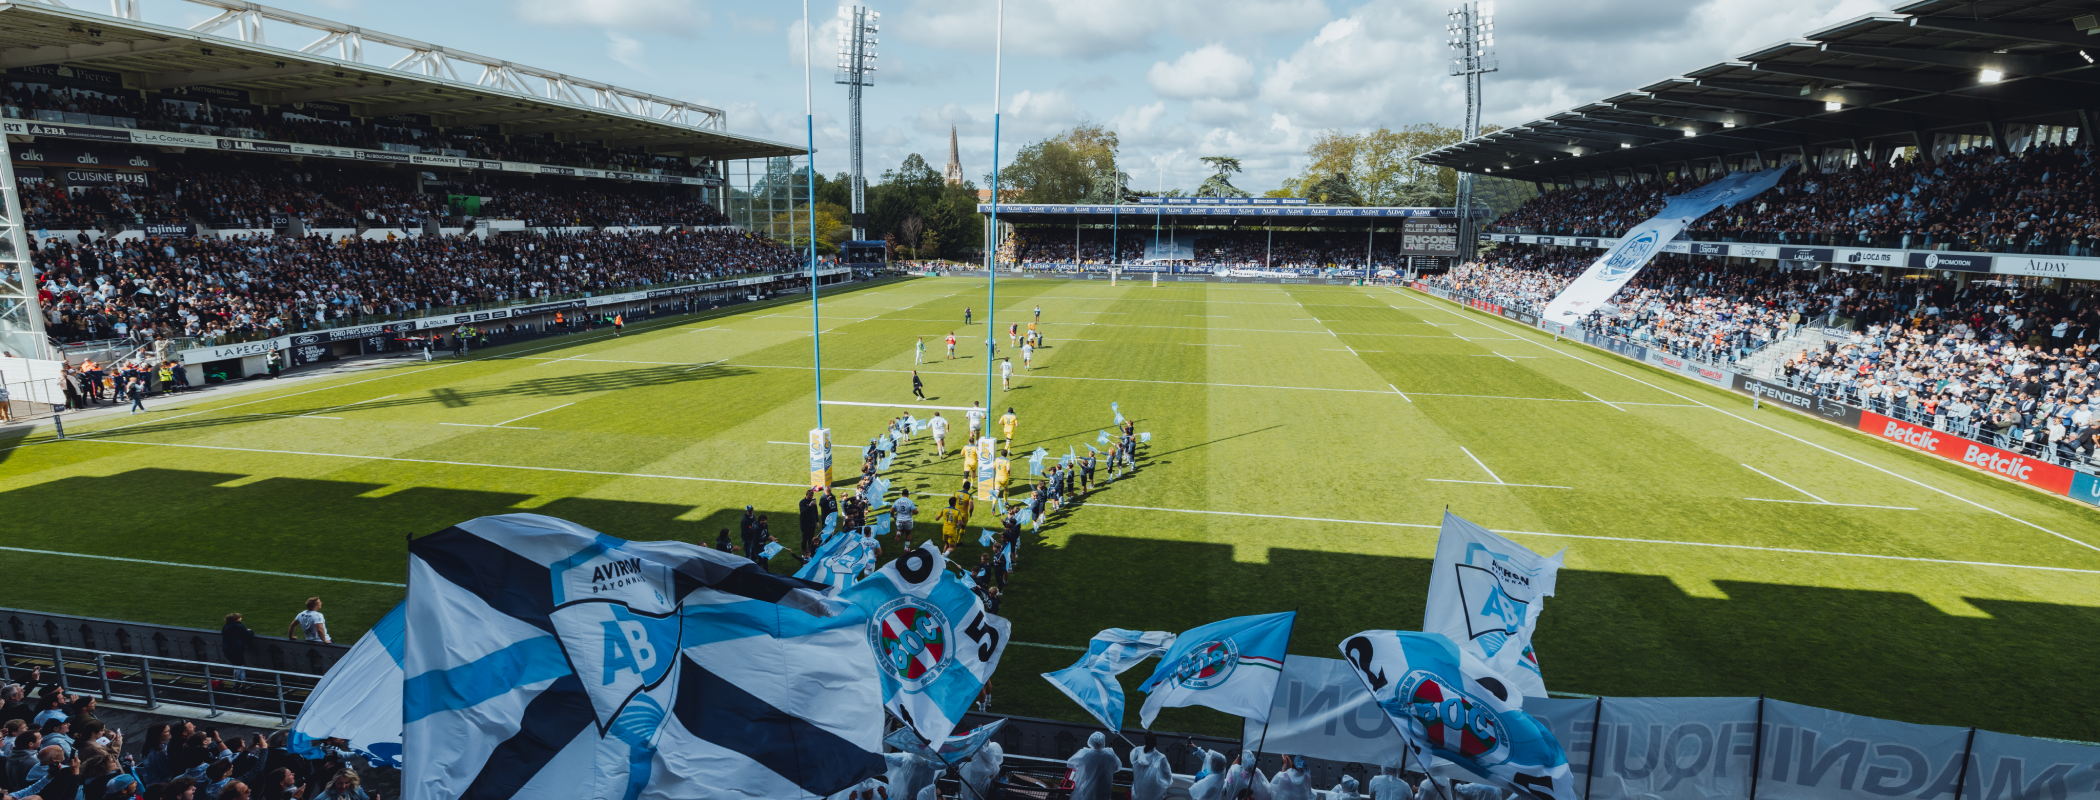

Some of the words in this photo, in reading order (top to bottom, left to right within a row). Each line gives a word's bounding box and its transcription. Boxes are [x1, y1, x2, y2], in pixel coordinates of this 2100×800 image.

[76, 68, 112, 83] Pierre
[43, 127, 67, 136] EBA
[234, 141, 256, 151] LML
[20, 148, 44, 161] alki
[77, 152, 99, 165] alki
[129, 155, 149, 168] alki
[67, 171, 114, 182] CUISINE
[115, 173, 145, 184] PLUS
[146, 224, 187, 235] tajinier
[1403, 235, 1457, 244] ENCORE
[1862, 253, 1880, 262] LOCA
[1938, 258, 1971, 267] PROMOTION
[2024, 259, 2069, 273] ALDAY
[429, 318, 447, 326] ROLLIN
[361, 326, 383, 334] BASQUE
[1596, 335, 1611, 349] GMF
[1624, 344, 1641, 359] GMF
[1883, 420, 1940, 451] Betclic
[1963, 444, 2033, 480] Betclic
[946, 515, 954, 523] 14
[592, 557, 642, 583] AVIRON
[1480, 584, 1519, 627] AB
[964, 611, 999, 663] 5
[600, 620, 657, 686] AB
[1345, 636, 1388, 692] 2
